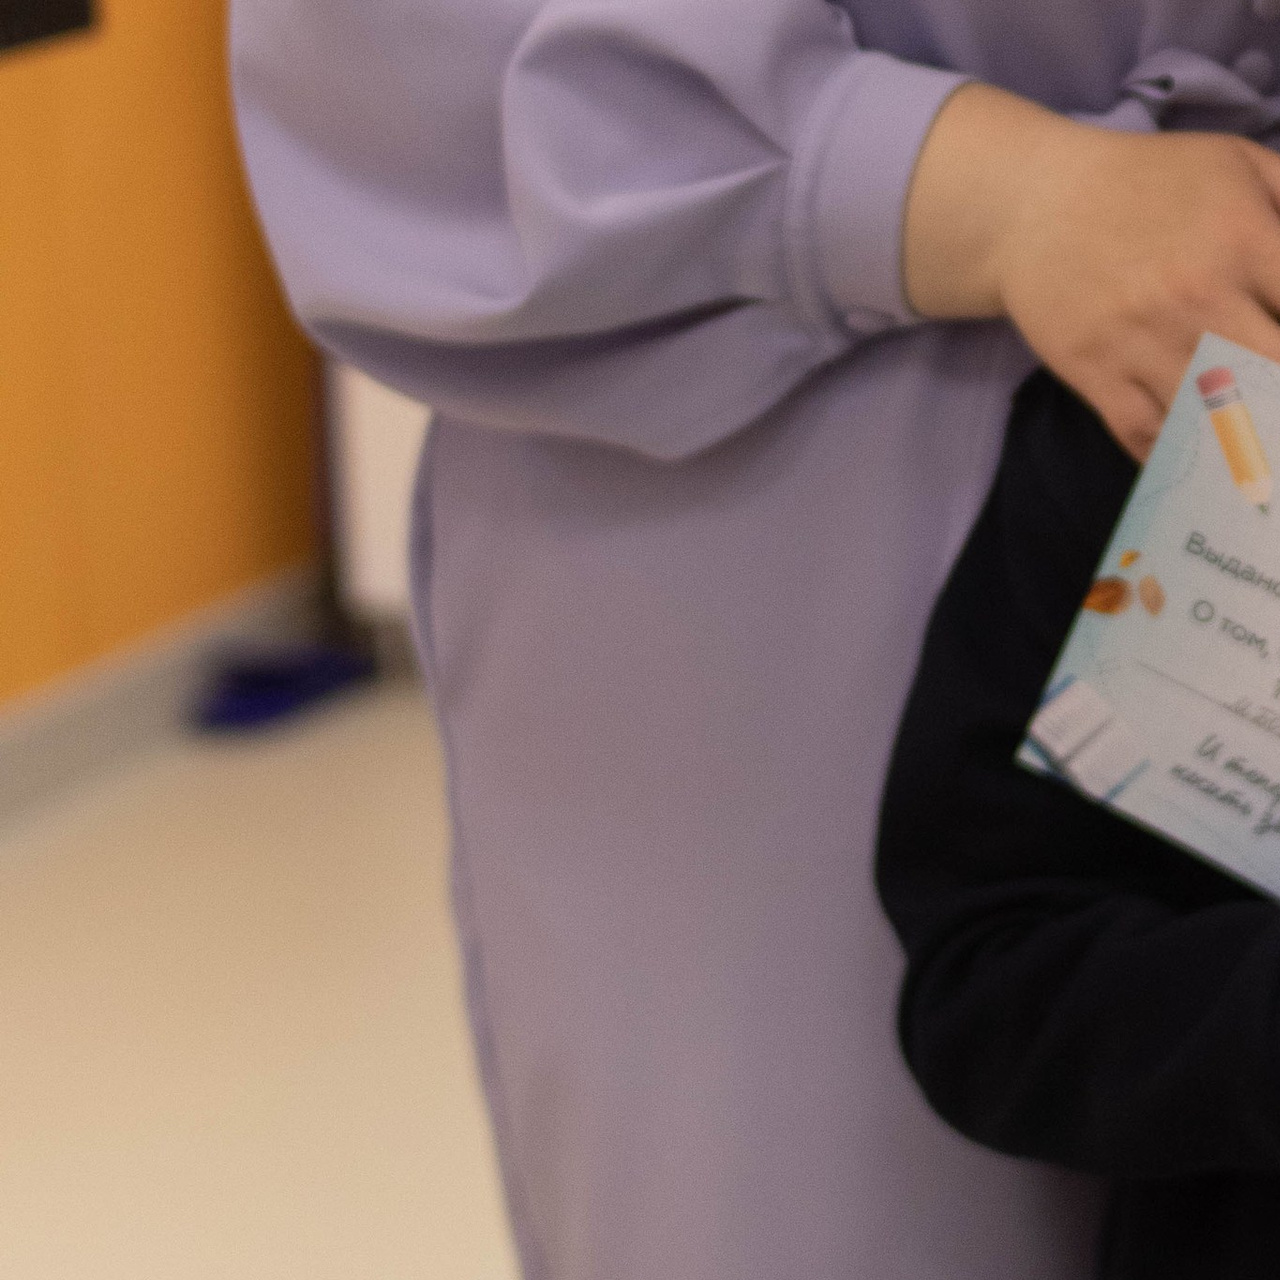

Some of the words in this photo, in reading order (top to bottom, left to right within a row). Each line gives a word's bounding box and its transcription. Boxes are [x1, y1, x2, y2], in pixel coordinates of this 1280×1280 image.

[1190, 600, 1216, 624] О
[1219, 616, 1269, 660] том,
[1195, 734, 1224, 764] И
[1169, 764, 1252, 817] носить
